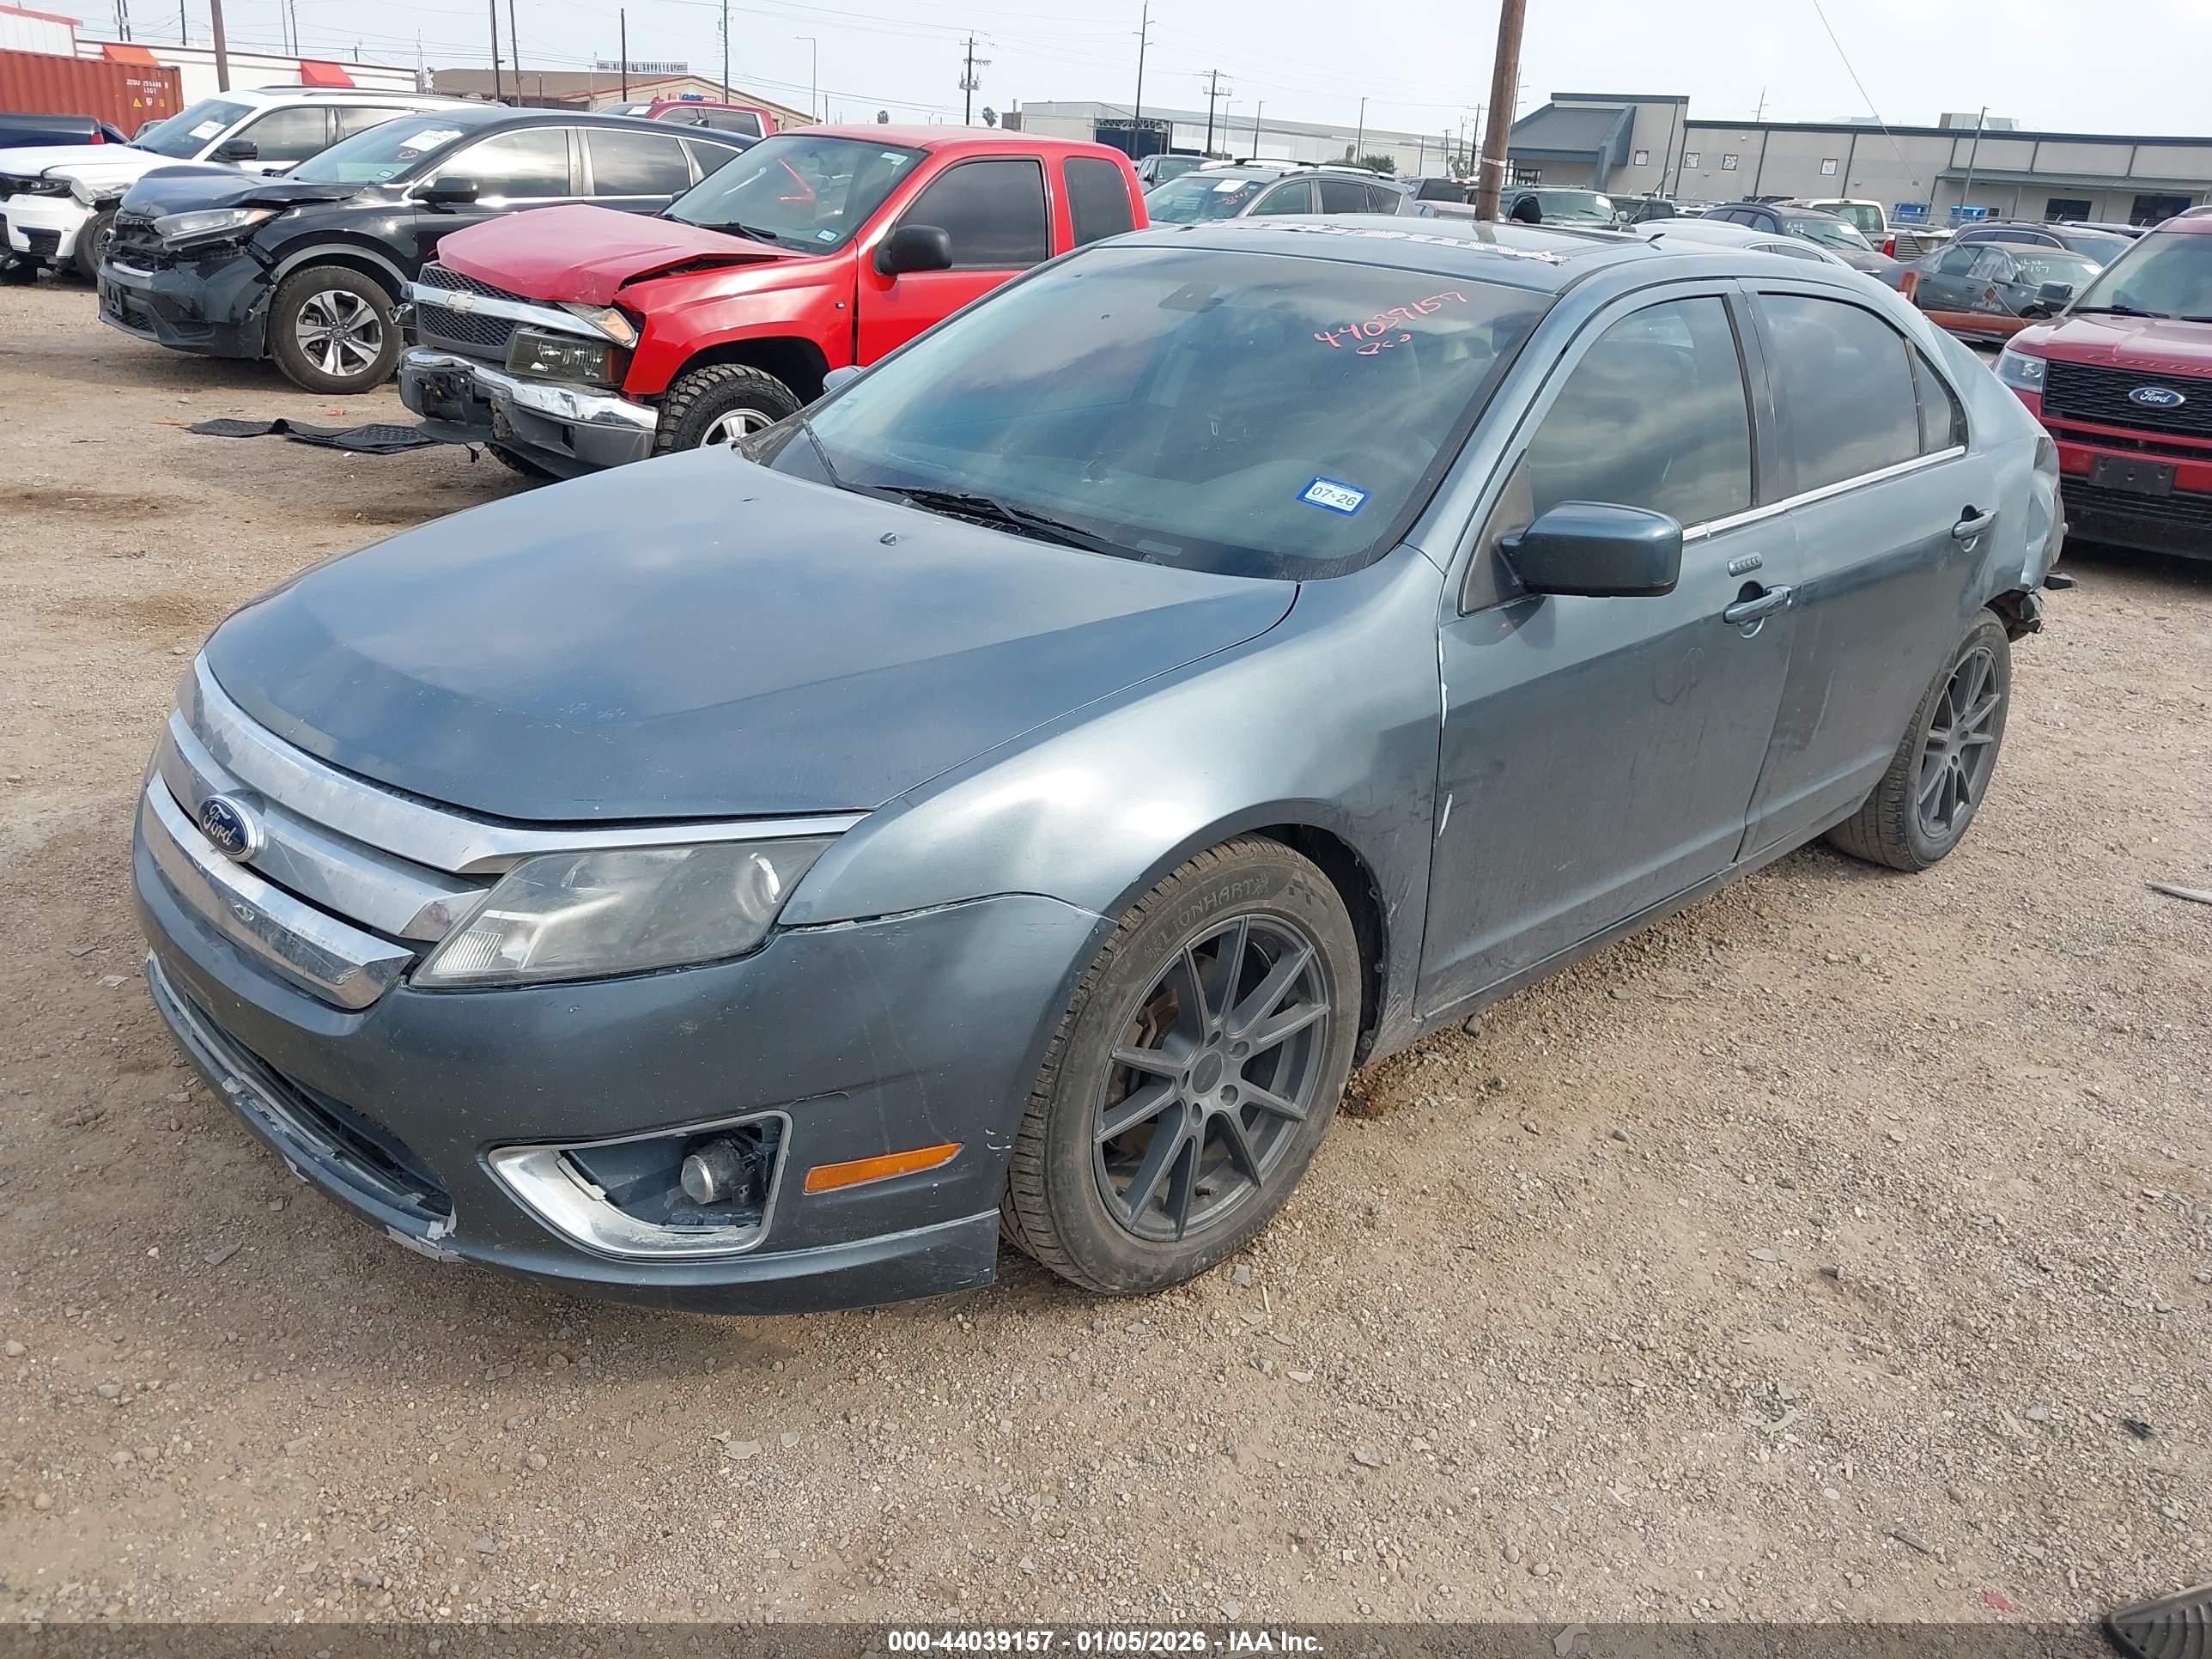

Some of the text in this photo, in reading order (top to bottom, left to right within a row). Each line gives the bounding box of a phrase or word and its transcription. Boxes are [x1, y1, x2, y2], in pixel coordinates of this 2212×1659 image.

[1314, 291, 1468, 348] 44039157
[2139, 390, 2172, 404] Ford
[203, 804, 237, 846] Ford
